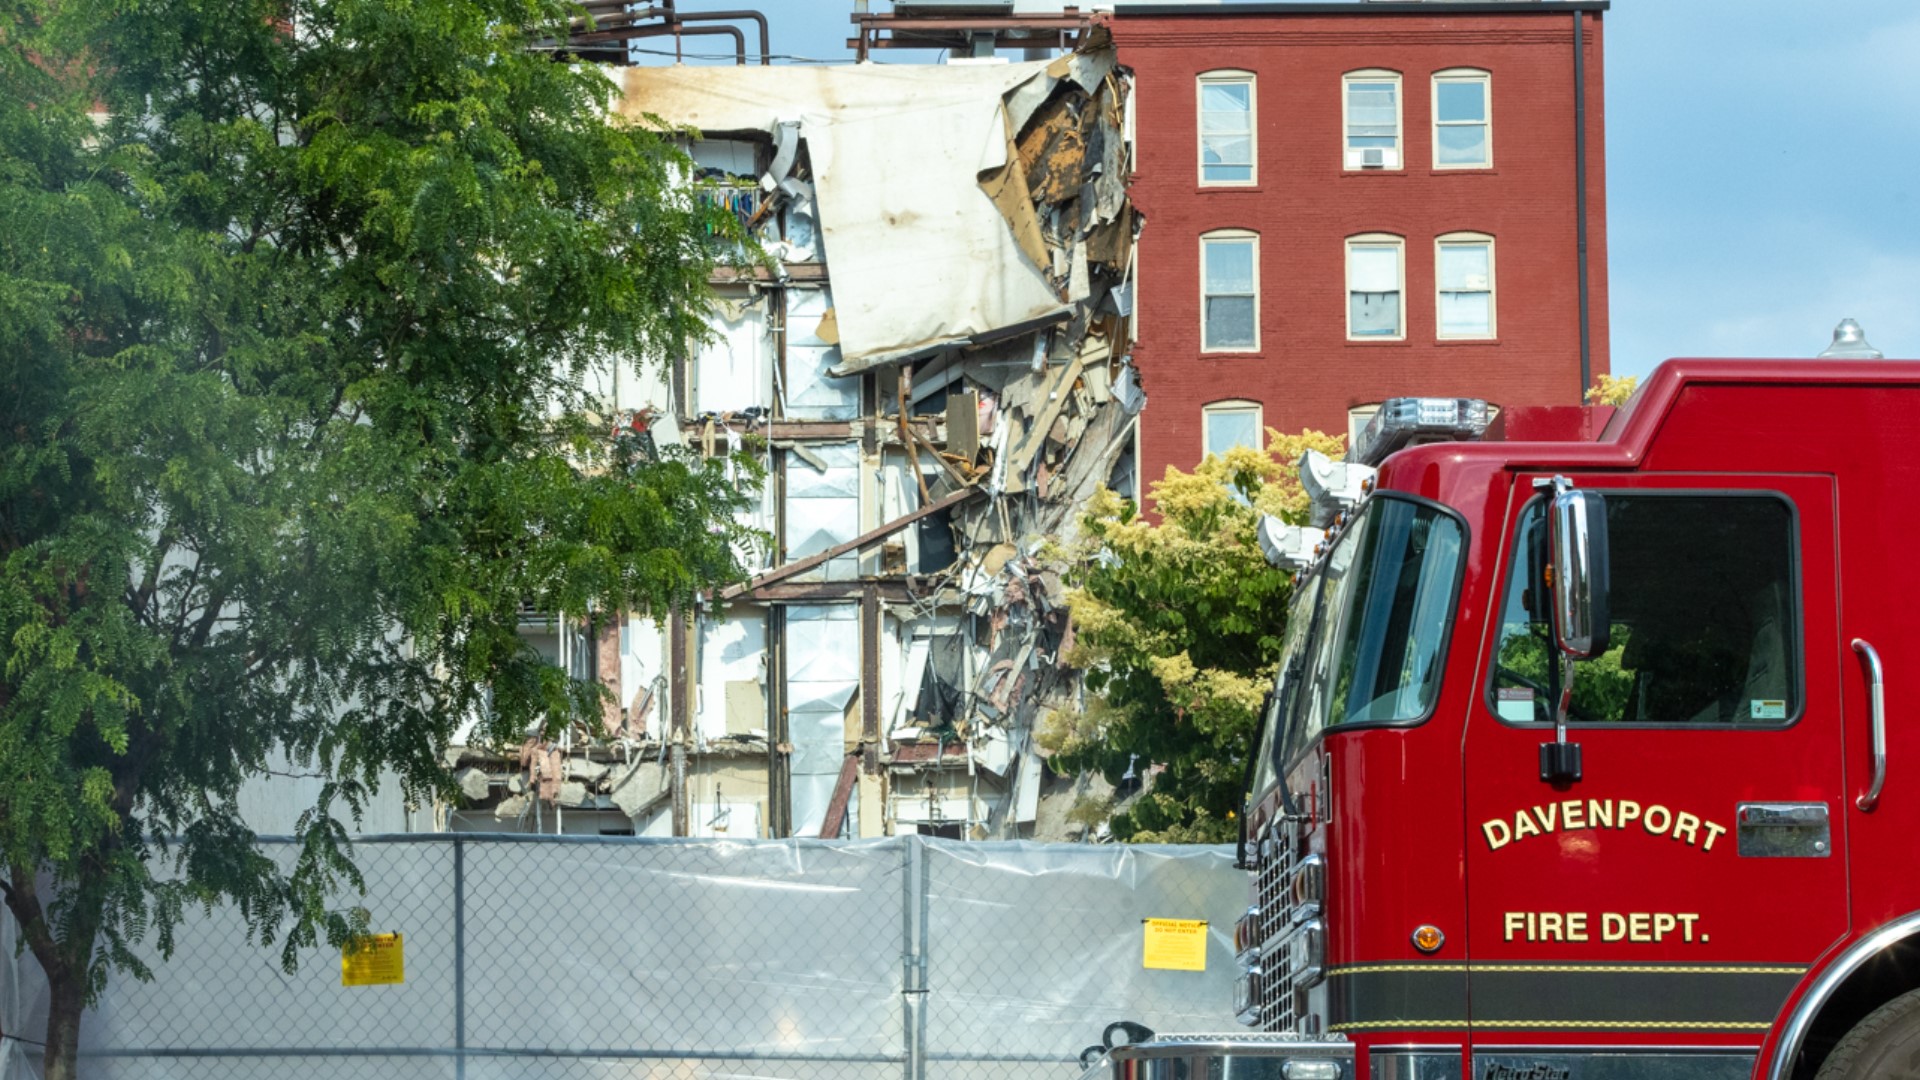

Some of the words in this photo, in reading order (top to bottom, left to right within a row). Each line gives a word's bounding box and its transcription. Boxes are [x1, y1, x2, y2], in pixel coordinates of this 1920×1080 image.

[1482, 799, 1727, 851] DAVENPORT
[1504, 912, 1589, 942] FIRE
[1601, 912, 1710, 942] DEPT.
